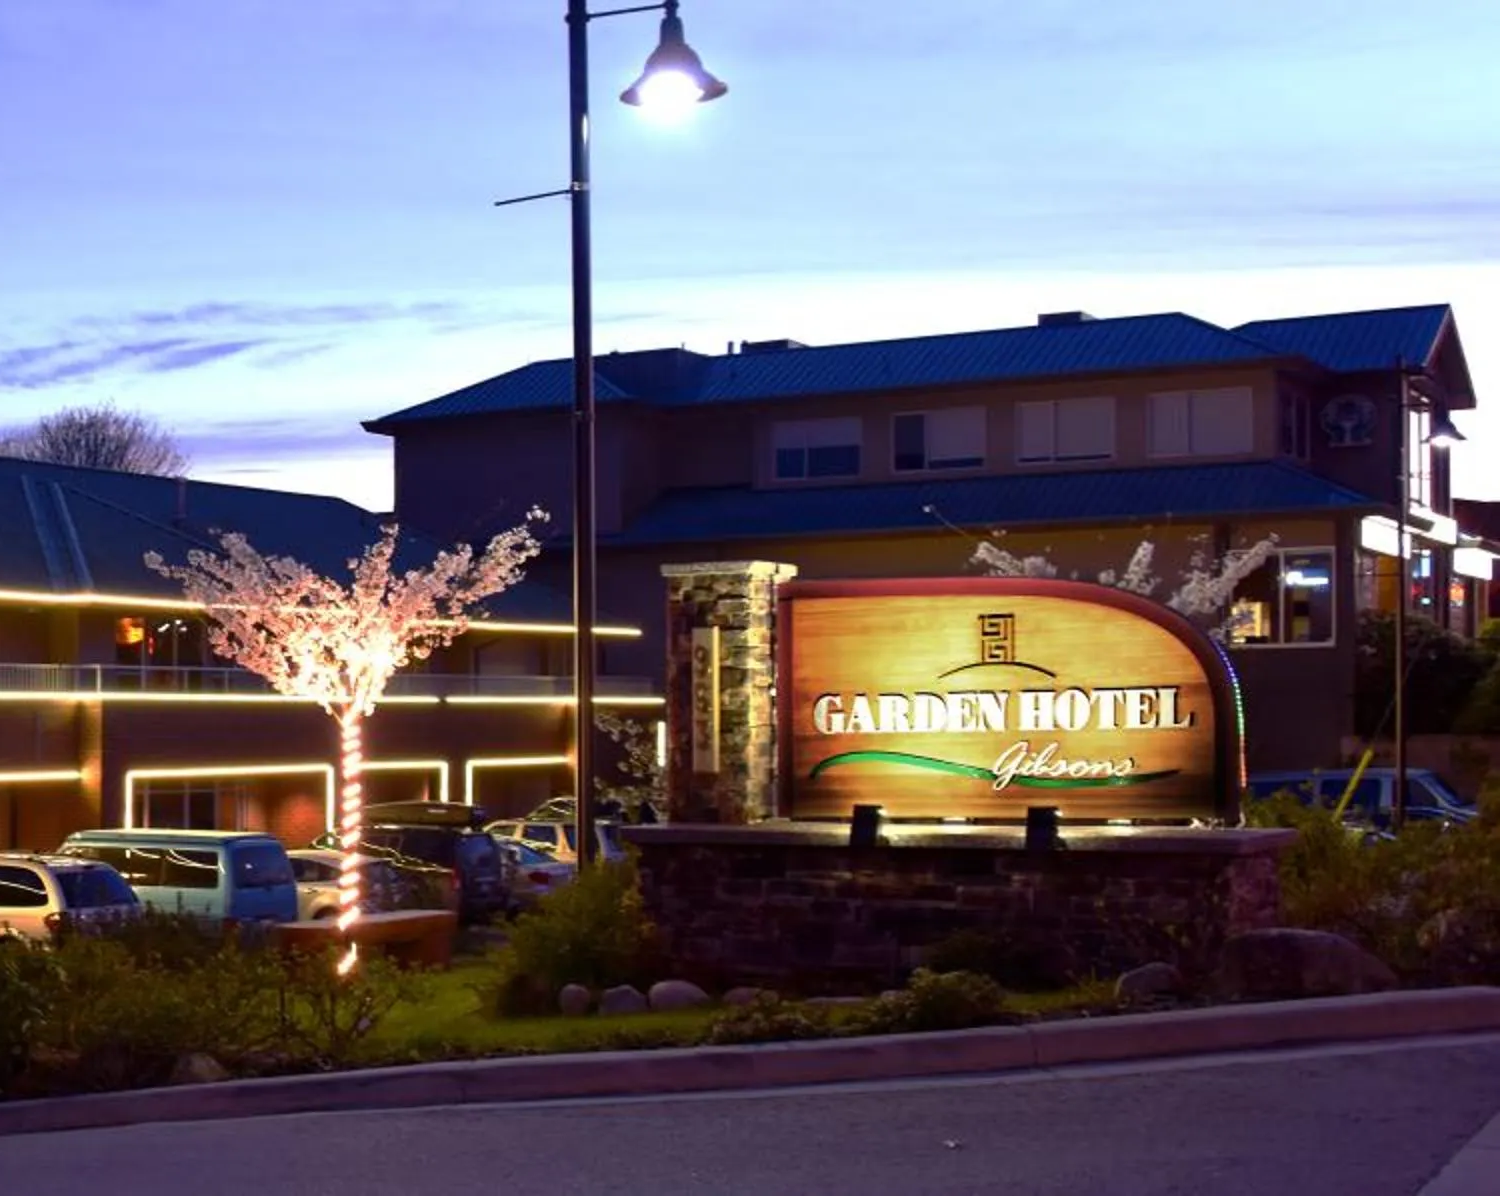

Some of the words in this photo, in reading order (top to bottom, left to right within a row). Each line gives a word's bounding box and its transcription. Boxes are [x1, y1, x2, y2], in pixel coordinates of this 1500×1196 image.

[813, 689, 1009, 735] GARDEN
[1017, 686, 1194, 732] HOTEL
[991, 740, 1134, 792] Gibsons
